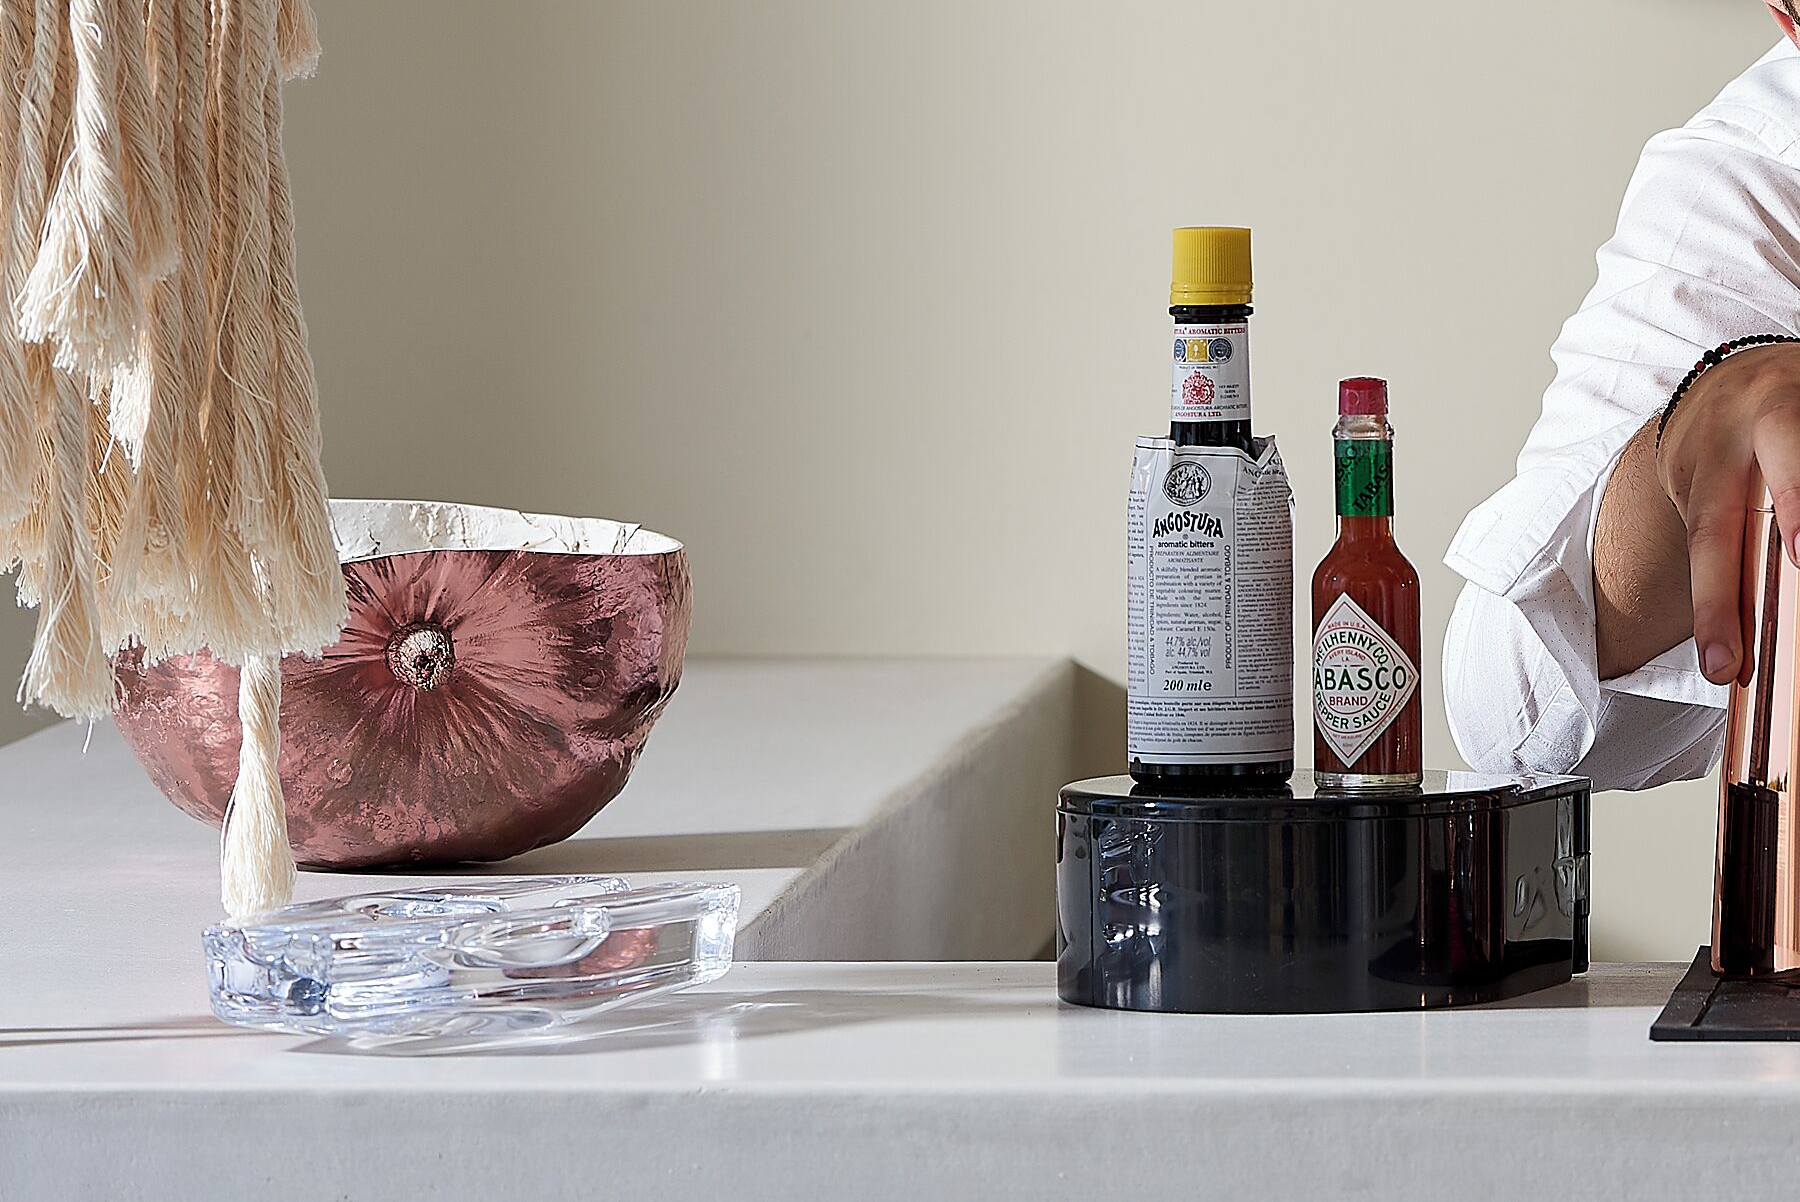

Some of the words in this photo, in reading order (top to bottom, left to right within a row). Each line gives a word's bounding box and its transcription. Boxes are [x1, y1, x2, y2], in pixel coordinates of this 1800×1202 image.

[1188, 327, 1223, 335] AROMATIC
[1152, 510, 1224, 538] ANGOSTURA
[1149, 590, 1154, 599] DE
[1225, 622, 1232, 632] OF
[1328, 621, 1341, 629] MADE
[1329, 650, 1345, 661] AVERY
[1345, 649, 1366, 661] ISLAND
[1313, 665, 1407, 691] ABASCO
[1163, 679, 1184, 691] 200
[1329, 696, 1368, 706] BRAND
[1315, 691, 1349, 730] PEPPER
[1353, 691, 1391, 729] SAUCE
